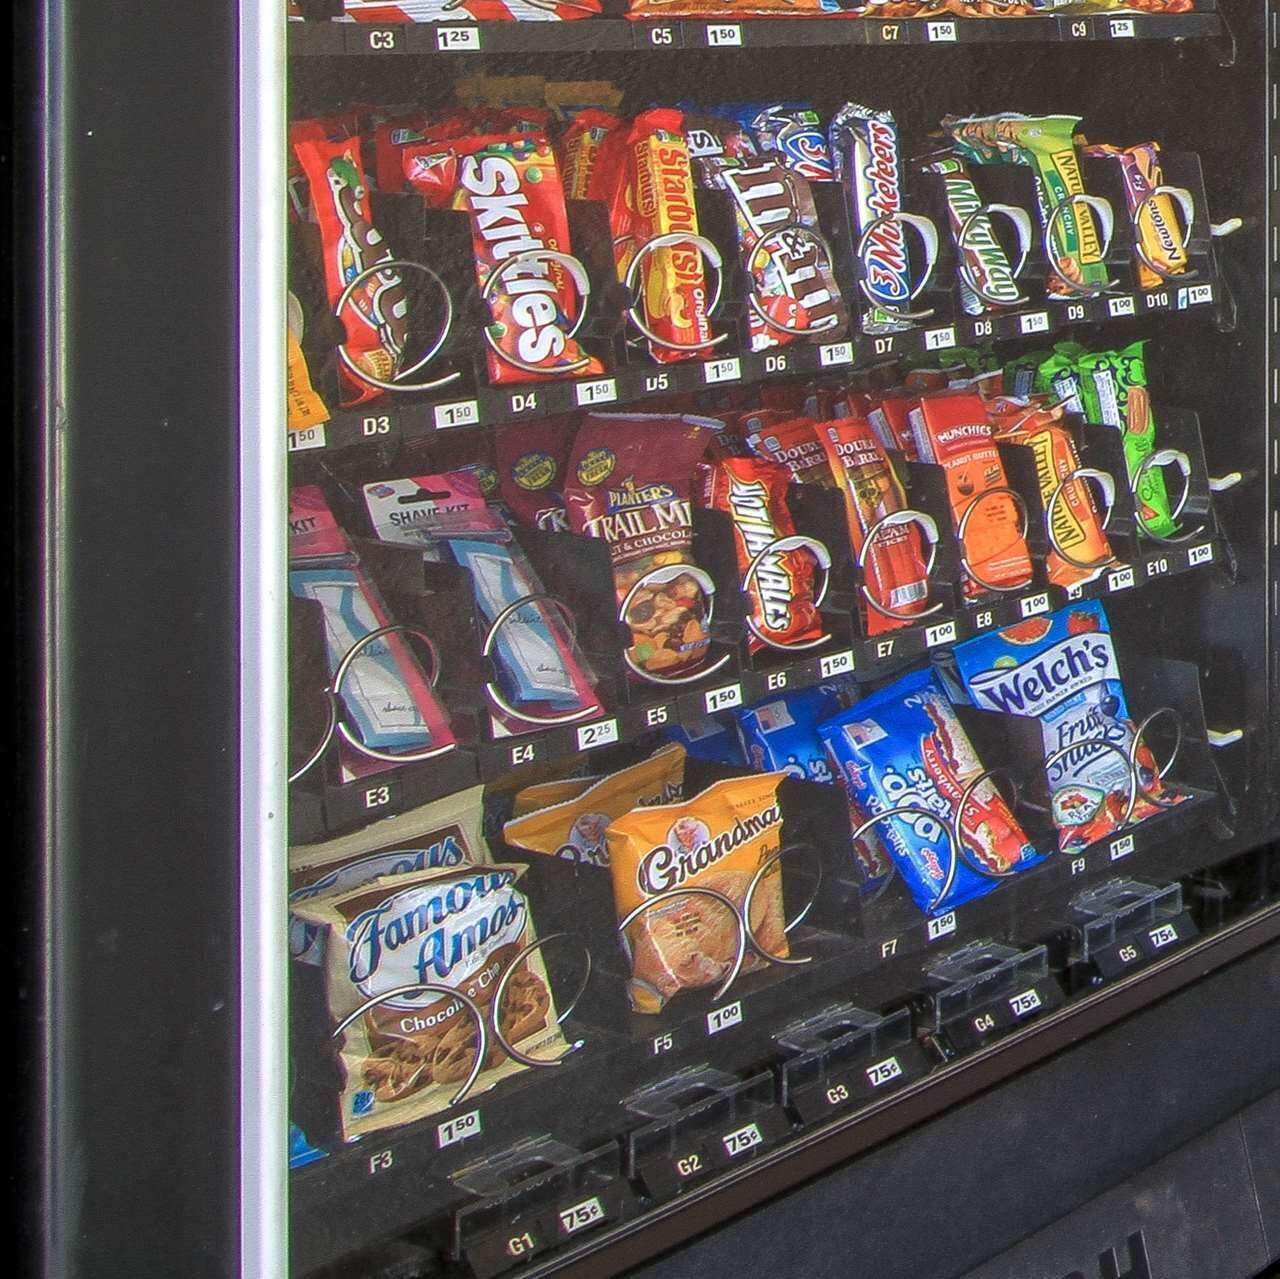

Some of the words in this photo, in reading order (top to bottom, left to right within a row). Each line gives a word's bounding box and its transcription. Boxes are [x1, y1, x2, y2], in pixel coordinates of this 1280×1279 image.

[651, 28, 673, 45] C5
[882, 25, 899, 40] C7
[1071, 21, 1087, 37] C9
[369, 31, 395, 49] C3
[1078, 206, 1101, 261] VALLEY
[1149, 199, 1182, 262] Newtons
[460, 154, 567, 364] Skittles
[1146, 292, 1169, 308] D10
[1068, 305, 1085, 320] D9
[974, 321, 993, 337] D8
[874, 337, 894, 355] D7
[765, 354, 786, 372] D6
[646, 374, 668, 392] D5
[511, 392, 538, 412] D4
[362, 417, 390, 436] D3
[937, 425, 993, 444] MUNCHIES
[607, 483, 675, 508] PLANTERS
[1146, 558, 1168, 577] E10
[976, 611, 993, 629] E8
[877, 641, 895, 658] E7
[767, 672, 787, 690] E6
[981, 640, 1110, 715] Welch's
[647, 706, 668, 726] E5
[511, 744, 536, 766] E4
[364, 786, 391, 808] E3
[1071, 858, 1086, 875] F9
[347, 871, 516, 983] Famous
[412, 890, 527, 1001] Amos
[1150, 928, 1176, 946] 75¢
[881, 940, 898, 959] F7
[1118, 946, 1137, 962] G5
[1011, 993, 1039, 1013] 75¢
[974, 1014, 995, 1033] G4
[654, 1035, 674, 1055] F5
[869, 1062, 899, 1083] 75¢
[827, 1084, 849, 1105] G3
[726, 1129, 758, 1153] 75¢
[369, 1150, 394, 1174] F3
[677, 1155, 703, 1176] G2
[562, 1203, 599, 1229] 75¢
[508, 1232, 535, 1257] G1
